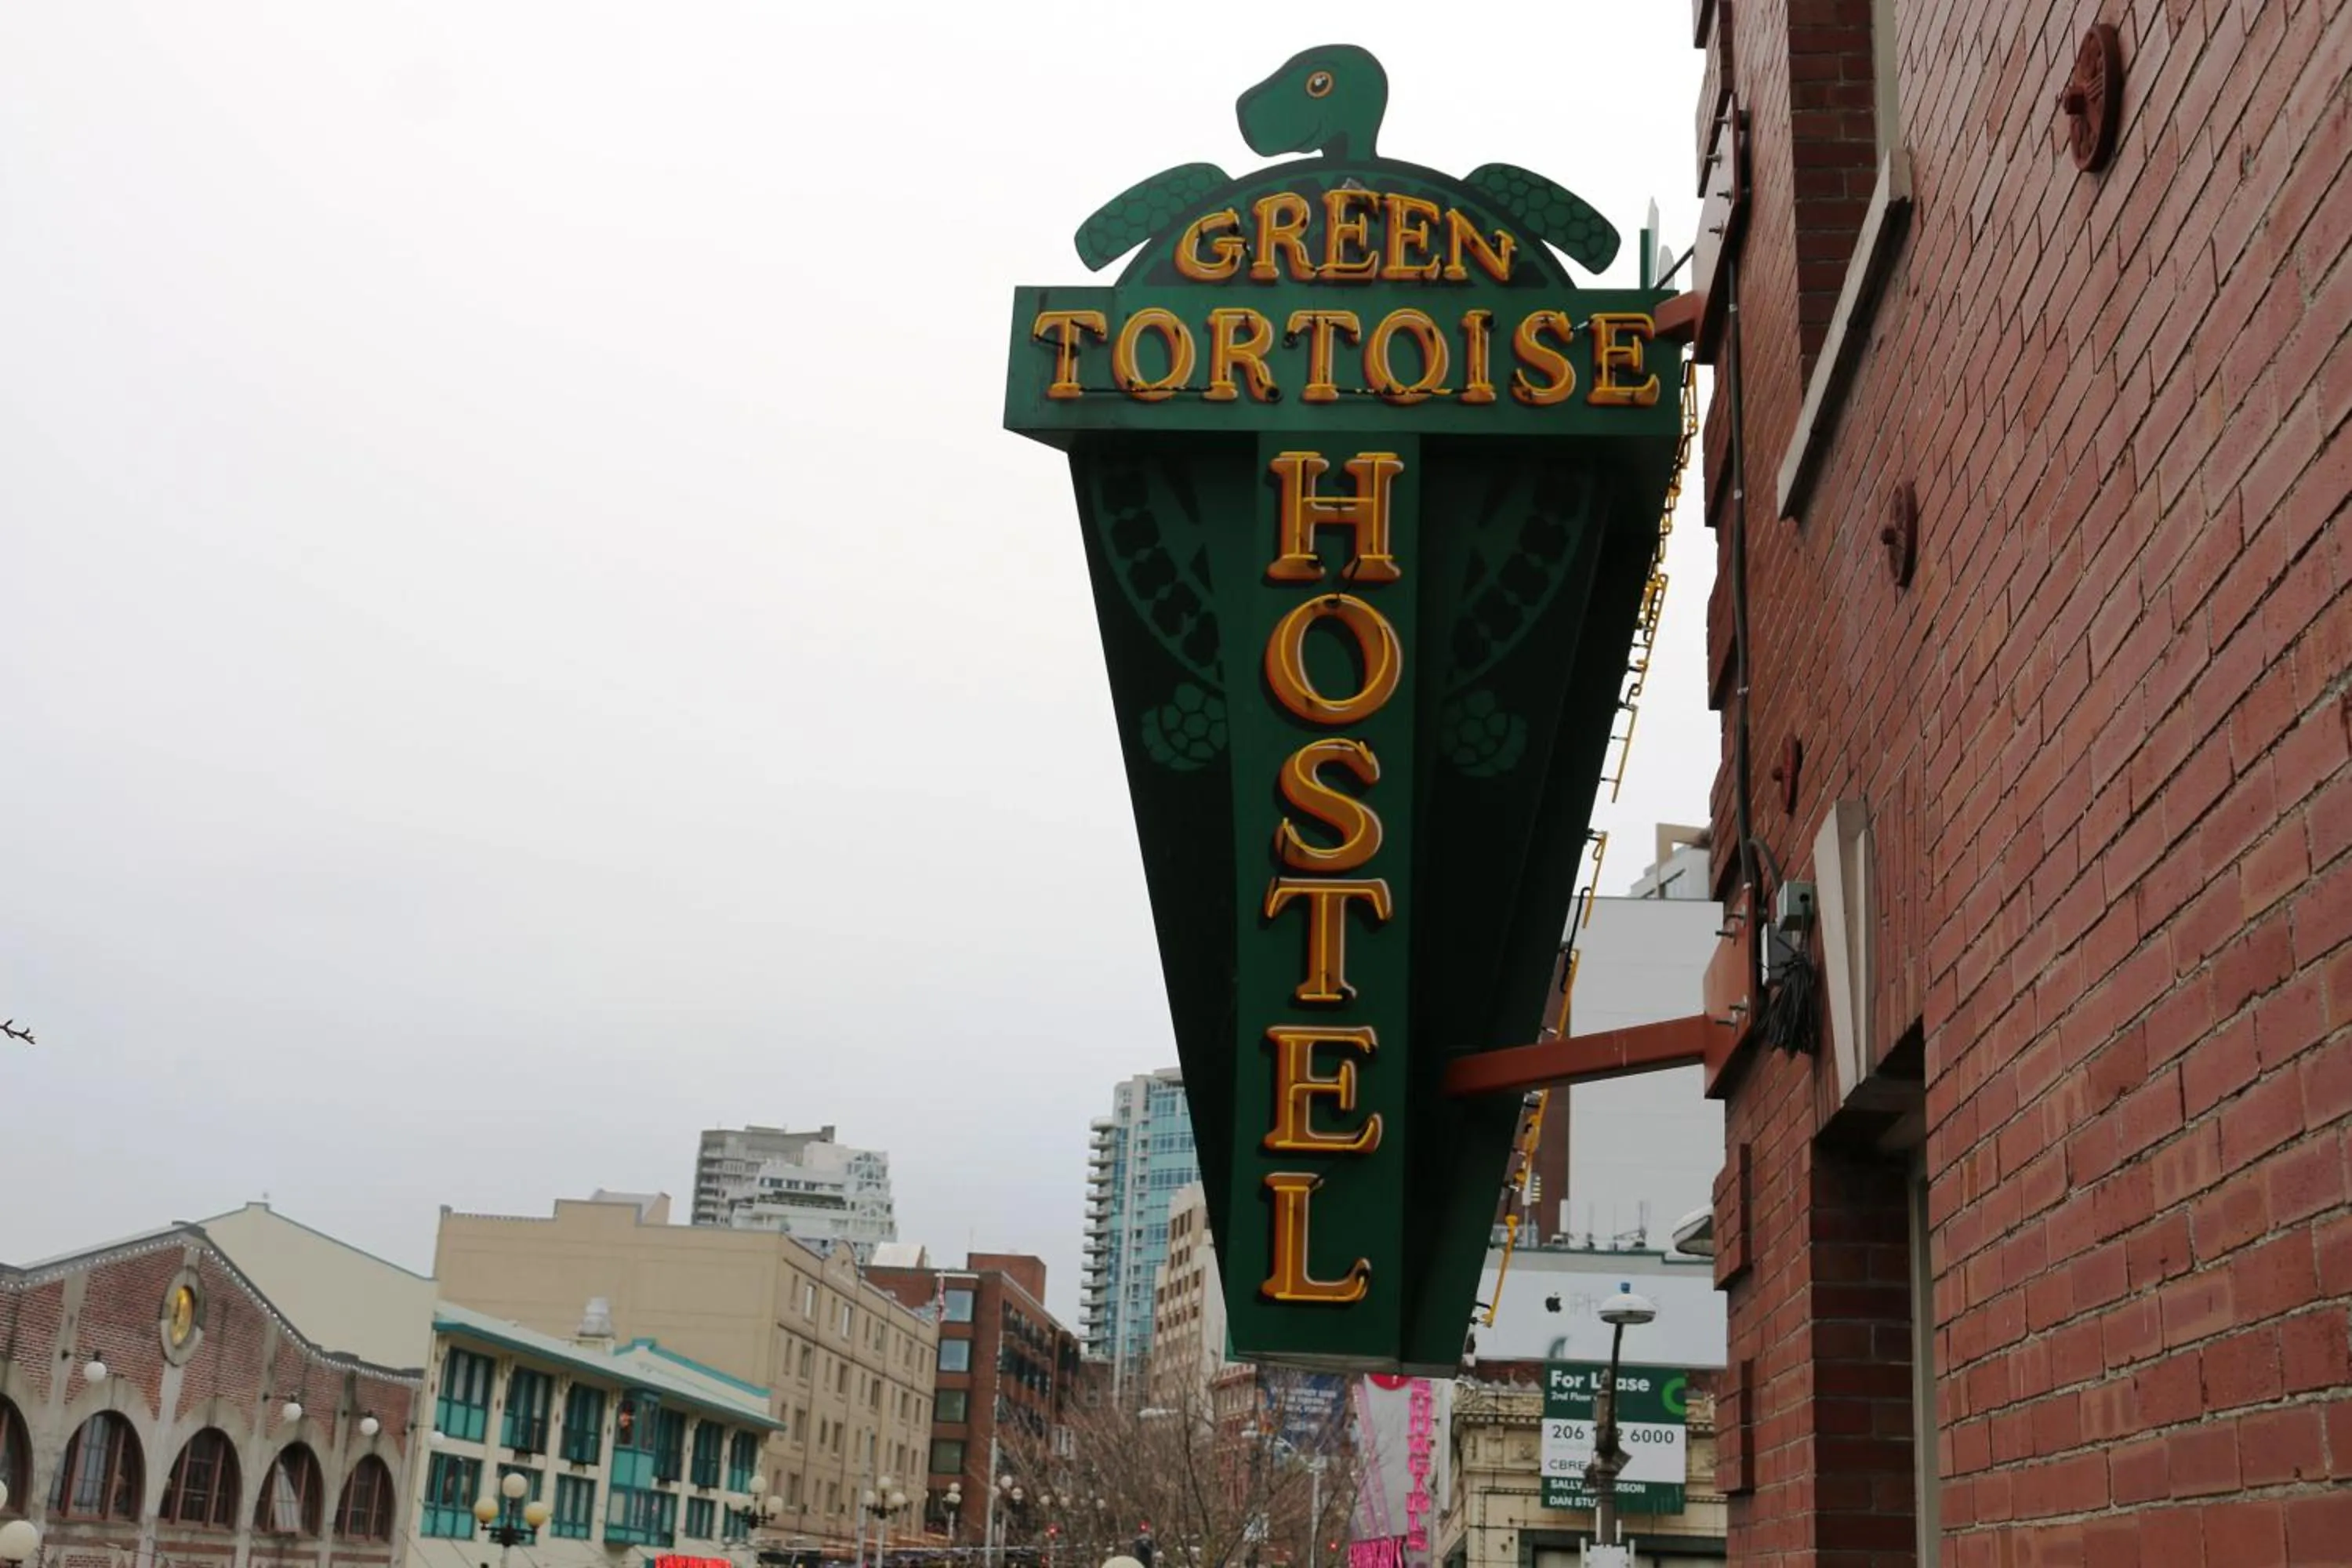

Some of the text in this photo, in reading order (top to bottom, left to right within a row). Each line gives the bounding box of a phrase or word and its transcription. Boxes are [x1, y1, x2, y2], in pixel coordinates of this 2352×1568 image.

[1174, 189, 1517, 281] GREEN
[1033, 307, 1661, 406] TORTOISE
[1261, 451, 1404, 1302] HOSTEL
[1551, 1370, 1650, 1392] For Lase
[1552, 1425, 1584, 1440] 206
[1630, 1428, 1675, 1443] 6000
[1549, 1459, 1587, 1471] CBRE
[1550, 1479, 1582, 1490] SALLY
[1549, 1496, 1573, 1505] DAN
